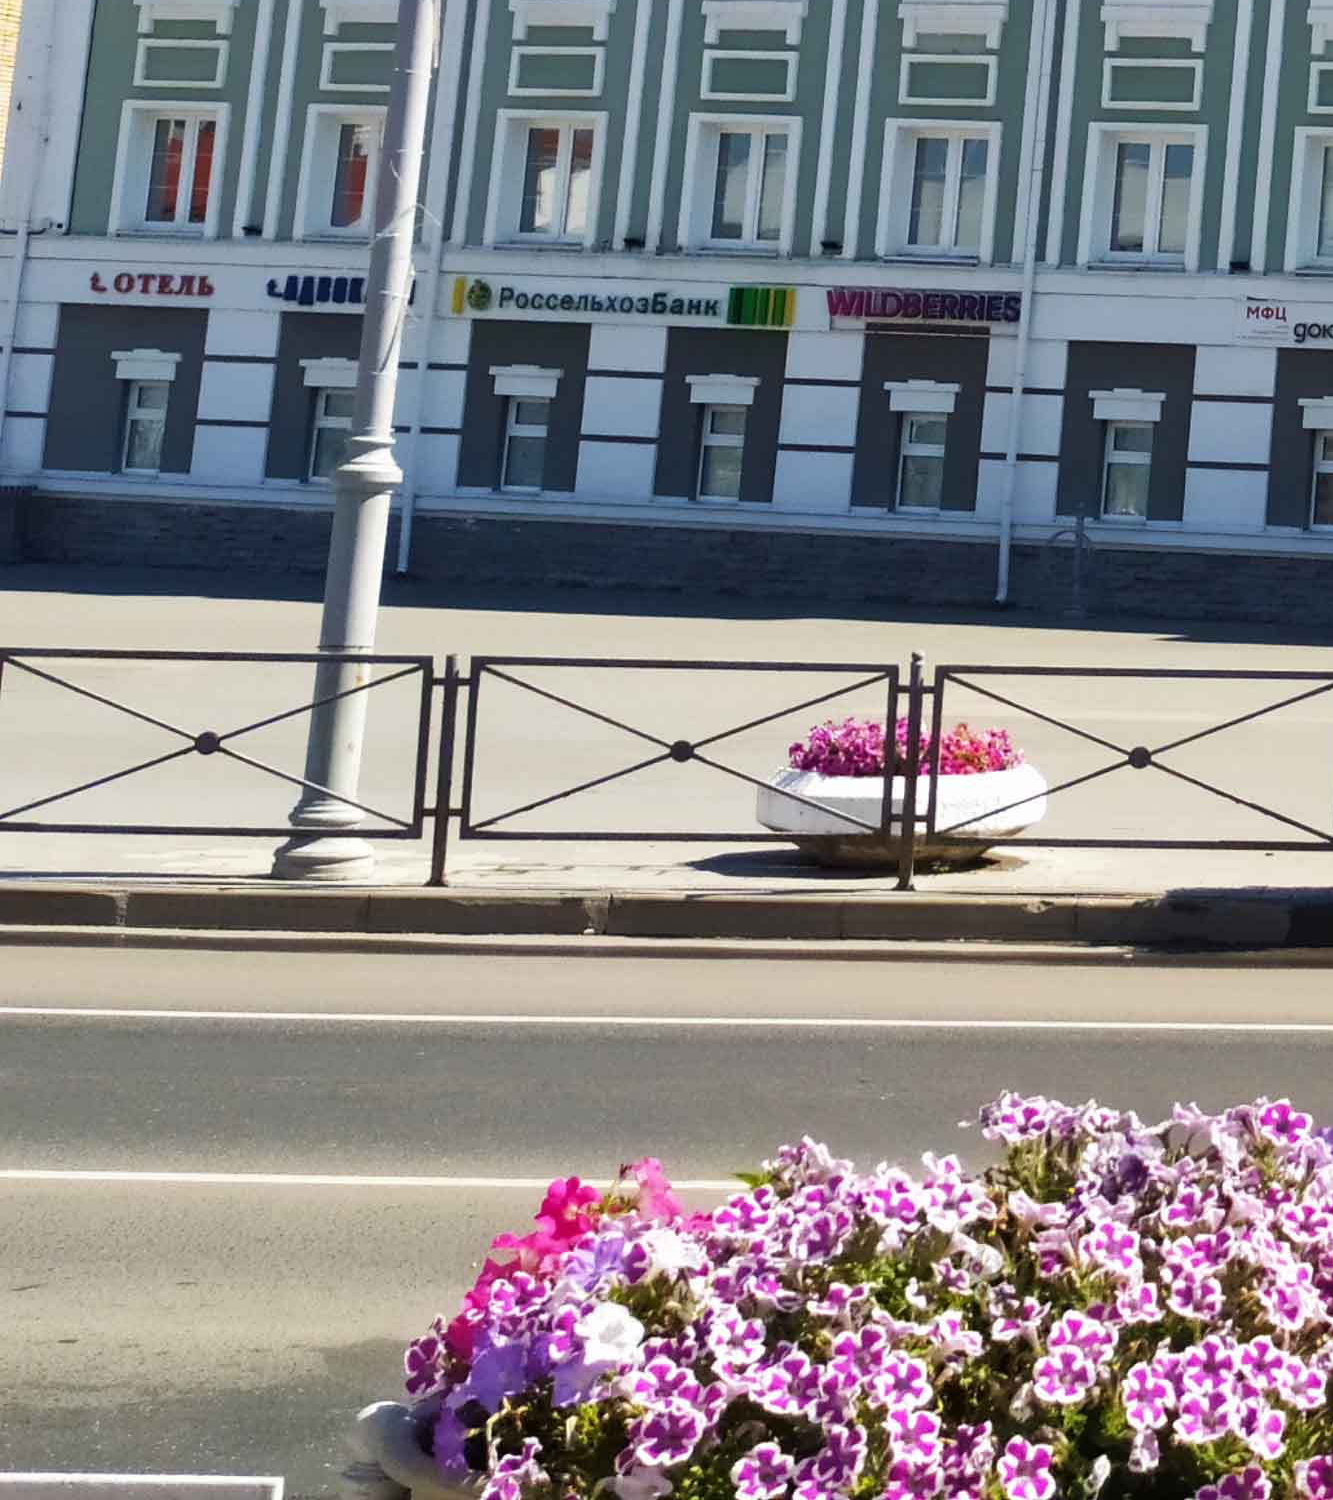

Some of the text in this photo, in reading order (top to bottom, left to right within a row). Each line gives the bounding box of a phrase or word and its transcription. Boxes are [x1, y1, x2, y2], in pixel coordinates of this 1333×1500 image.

[113, 273, 216, 297] ОТЕЛЬ
[499, 286, 720, 318] РоссельхозБанк
[827, 288, 1023, 322] WILDBERRIES
[1246, 306, 1288, 322] МФЦ
